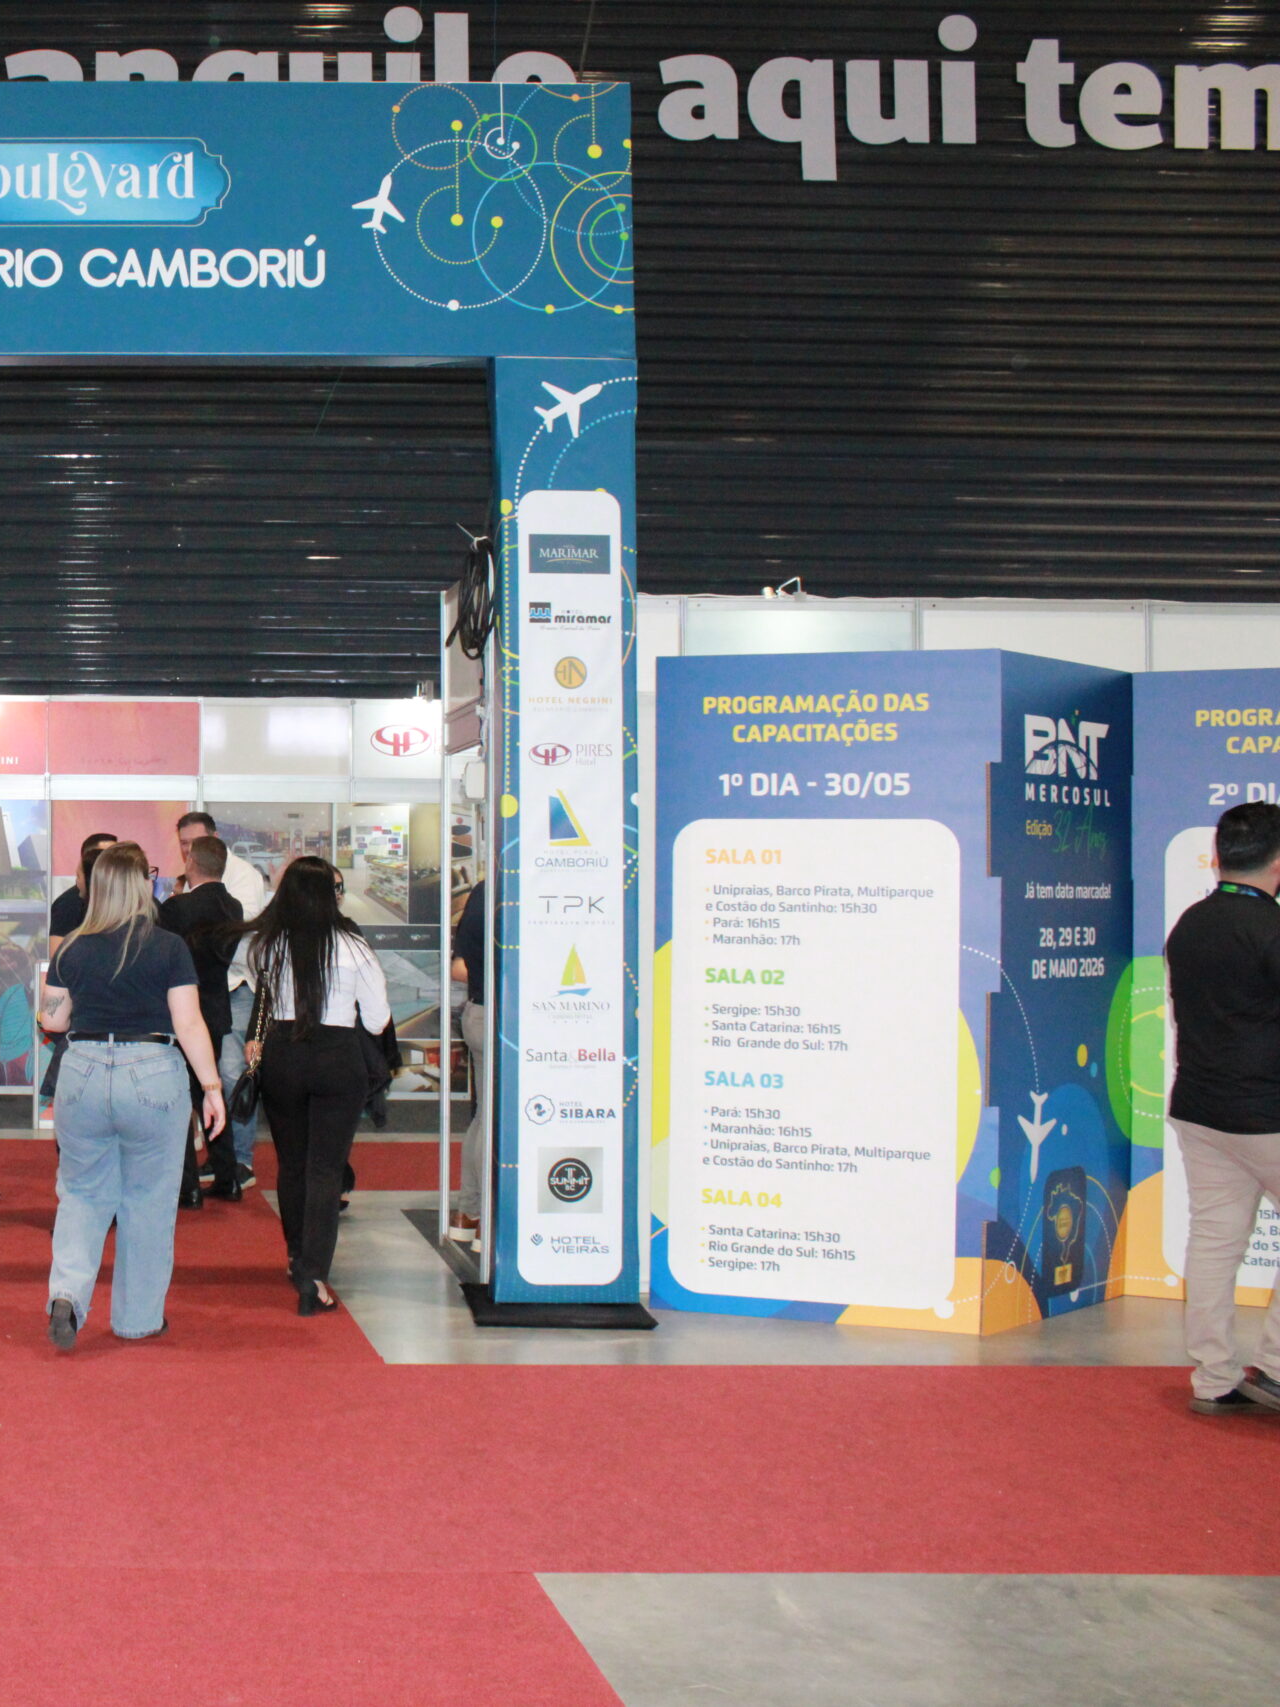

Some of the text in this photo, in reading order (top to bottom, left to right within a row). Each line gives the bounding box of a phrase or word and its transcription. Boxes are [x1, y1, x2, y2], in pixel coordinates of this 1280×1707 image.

[658, 14, 977, 182] aqui
[1016, 38, 1280, 151] tem
[80, 234, 326, 288] CAMBORIÚ
[539, 548, 599, 559] MARIMAR
[554, 613, 612, 624] miramar
[529, 696, 613, 705] HOTEL NEGRINI
[703, 690, 929, 717] PROGRAMAÇÃO DAS
[732, 719, 898, 747] CAPACITAÇÕES
[576, 743, 613, 757] PIRES
[1024, 713, 1110, 780] BNT
[750, 773, 800, 796] DIA
[825, 772, 911, 798] 30/05
[1025, 782, 1111, 807] MERCOSUL
[1026, 819, 1053, 839] Edição
[535, 855, 609, 868] CAMBORIÚ
[705, 849, 782, 865] SALA 01
[713, 885, 934, 900] Unipraias, Barco Pirata, Multiparque
[1025, 881, 1111, 900] Já tem data marcada!
[538, 896, 605, 914] TPK
[705, 901, 877, 914] e Costão do Santinho: 15h30
[713, 917, 780, 929] Pará: 16h15
[713, 934, 800, 946] Maranhão: 17h
[1039, 926, 1096, 950] 28, 29 E 30
[1032, 957, 1104, 980] DE MAIO 2026
[705, 968, 784, 985] SALA 02
[532, 1001, 610, 1011] SAN MARINO
[712, 1004, 800, 1017] Sergipe: 15h30
[712, 1021, 841, 1035] Santa Catarina: 16h15
[712, 1037, 848, 1052] Rio Grande do Sul: 17h
[526, 1049, 616, 1063] Santa Bella
[704, 1071, 784, 1089] SALA 03
[560, 1108, 616, 1119] SIBARA
[711, 1106, 781, 1120] Pará: 15h30
[711, 1123, 812, 1138] Maranhão: 16h15
[710, 1139, 931, 1162] Unipraias, Barco Pirata, Multiparque
[702, 1155, 858, 1173] e Costão do Santinho: 17h
[701, 1188, 782, 1208] SALA 04
[551, 1236, 600, 1245] HOTEL
[709, 1224, 840, 1243] Santa Catarina: 15h30
[552, 1245, 609, 1254] VIEIRAS
[709, 1241, 855, 1261] Rio Grande do Sul: 16h15
[708, 1257, 780, 1272] Sergipe: 17h
